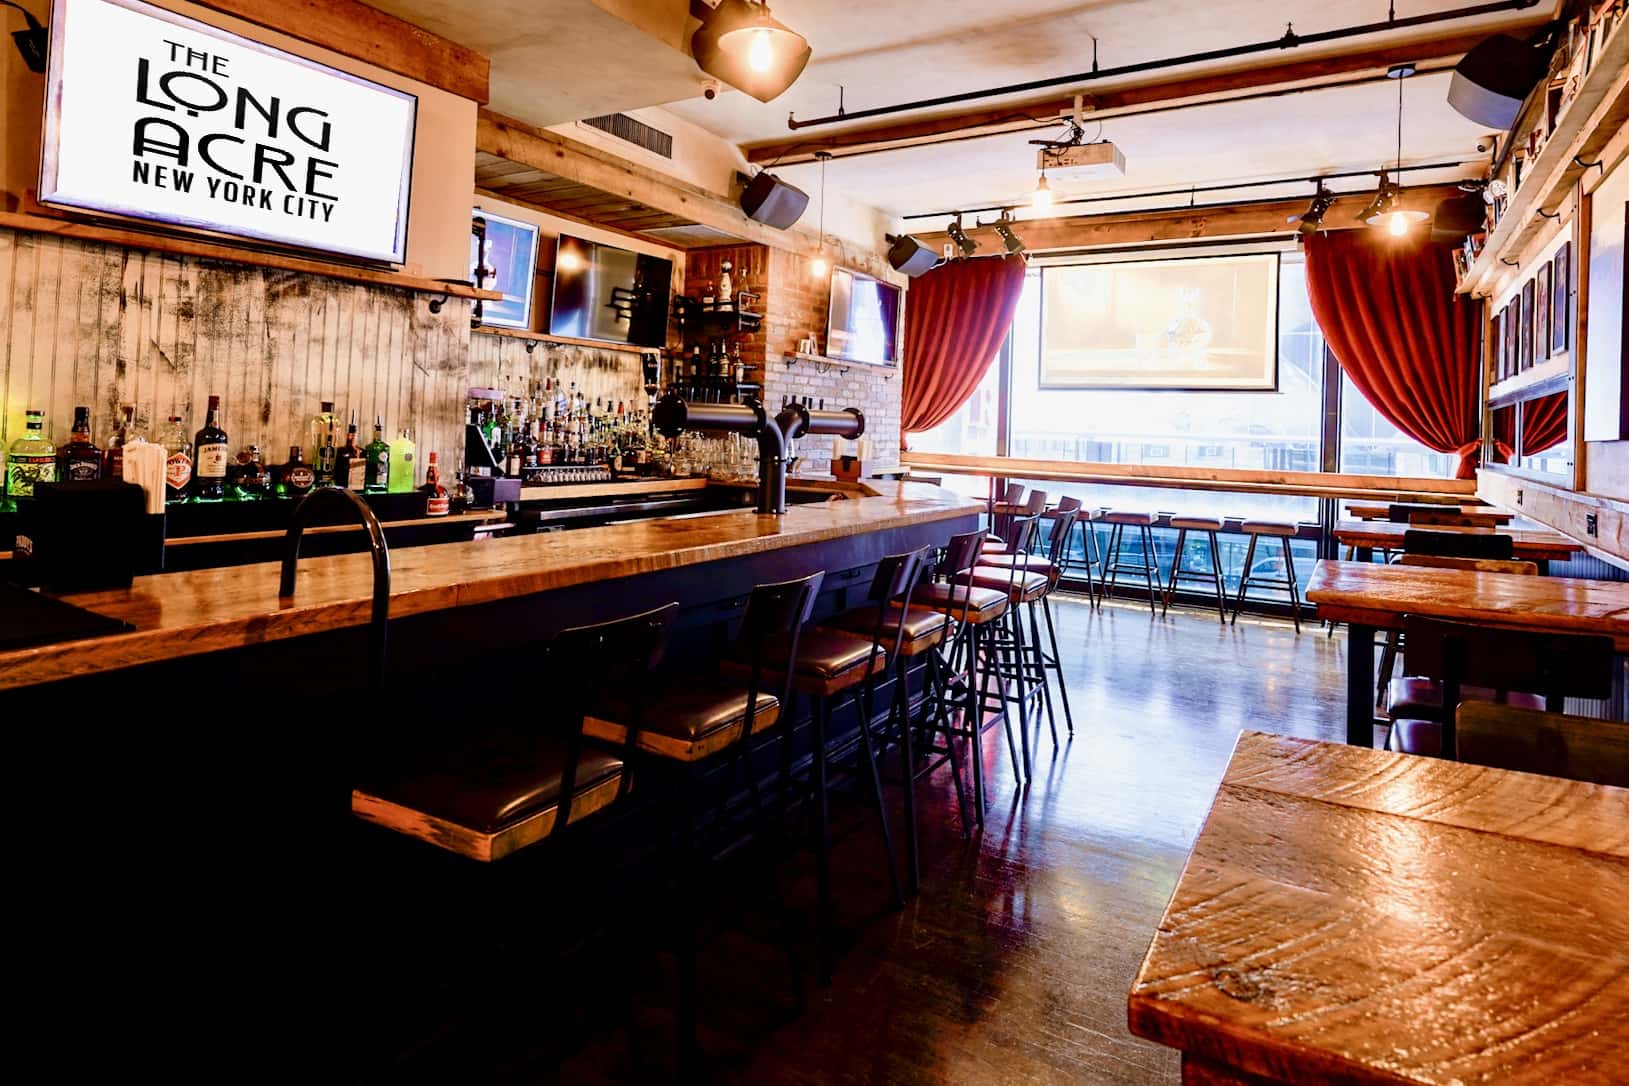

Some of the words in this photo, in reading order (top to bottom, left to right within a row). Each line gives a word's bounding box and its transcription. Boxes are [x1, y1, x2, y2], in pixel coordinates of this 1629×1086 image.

[163, 39, 230, 78] THE
[136, 57, 332, 153] LONG
[132, 116, 339, 202] ACRE
[132, 159, 195, 194] NEW
[206, 176, 273, 211] YORK
[283, 194, 334, 223] CITY
